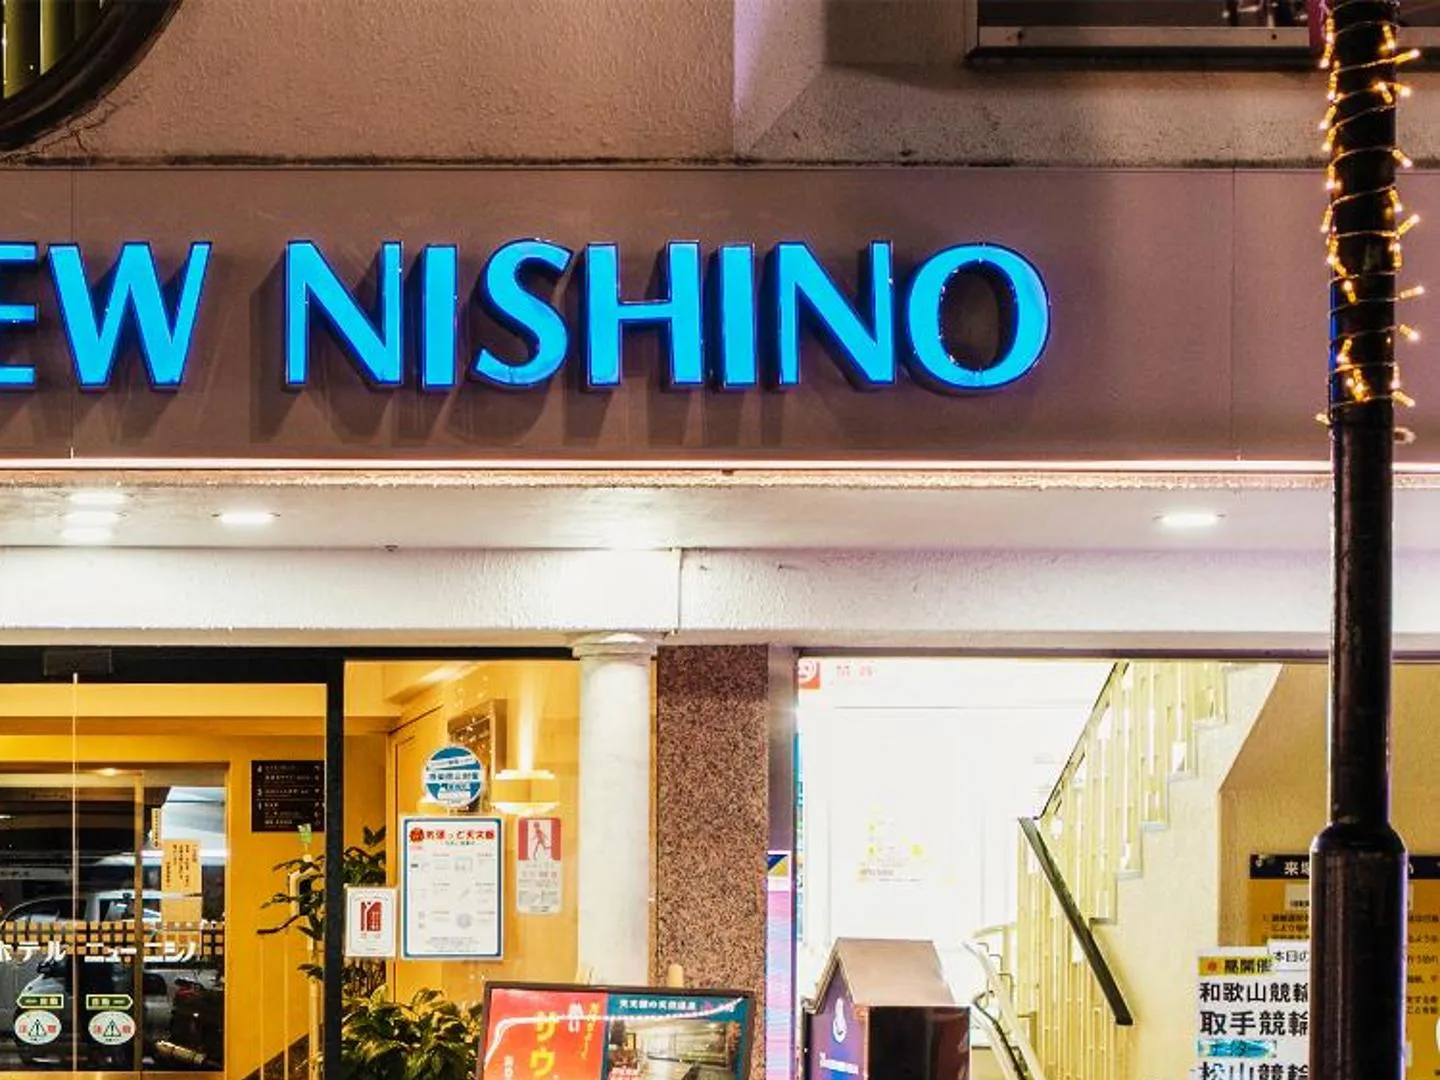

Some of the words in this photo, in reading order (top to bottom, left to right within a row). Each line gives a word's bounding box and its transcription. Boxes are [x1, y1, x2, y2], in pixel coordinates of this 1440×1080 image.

[286, 238, 1052, 391] NISHINO
[1199, 982, 1309, 1003] 和歌山競輪
[1200, 1010, 1309, 1036] 取手競輪
